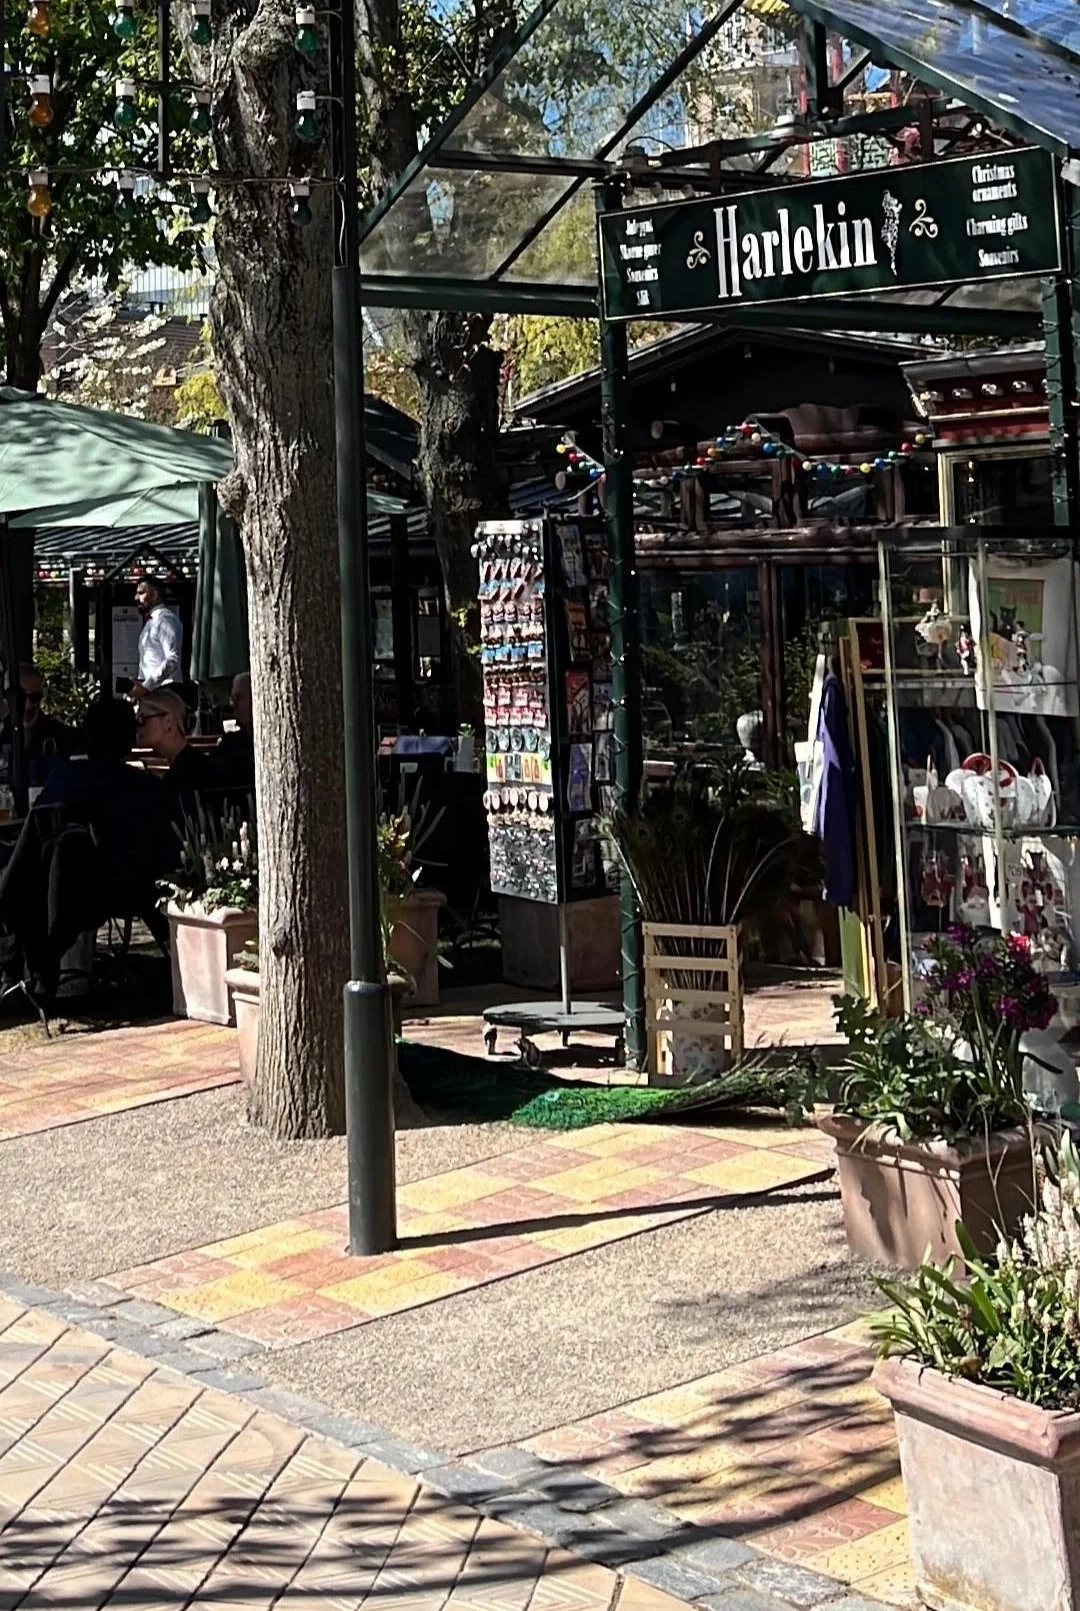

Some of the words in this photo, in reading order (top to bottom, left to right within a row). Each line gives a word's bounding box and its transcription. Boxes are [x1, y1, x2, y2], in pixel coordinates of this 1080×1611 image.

[972, 163, 1016, 184] Christmas
[972, 180, 1018, 203] ornaments
[966, 214, 1007, 237] Charming
[1007, 212, 1029, 236] gifts
[713, 200, 878, 299] Harlekin
[977, 245, 1020, 268] Souvenirs
